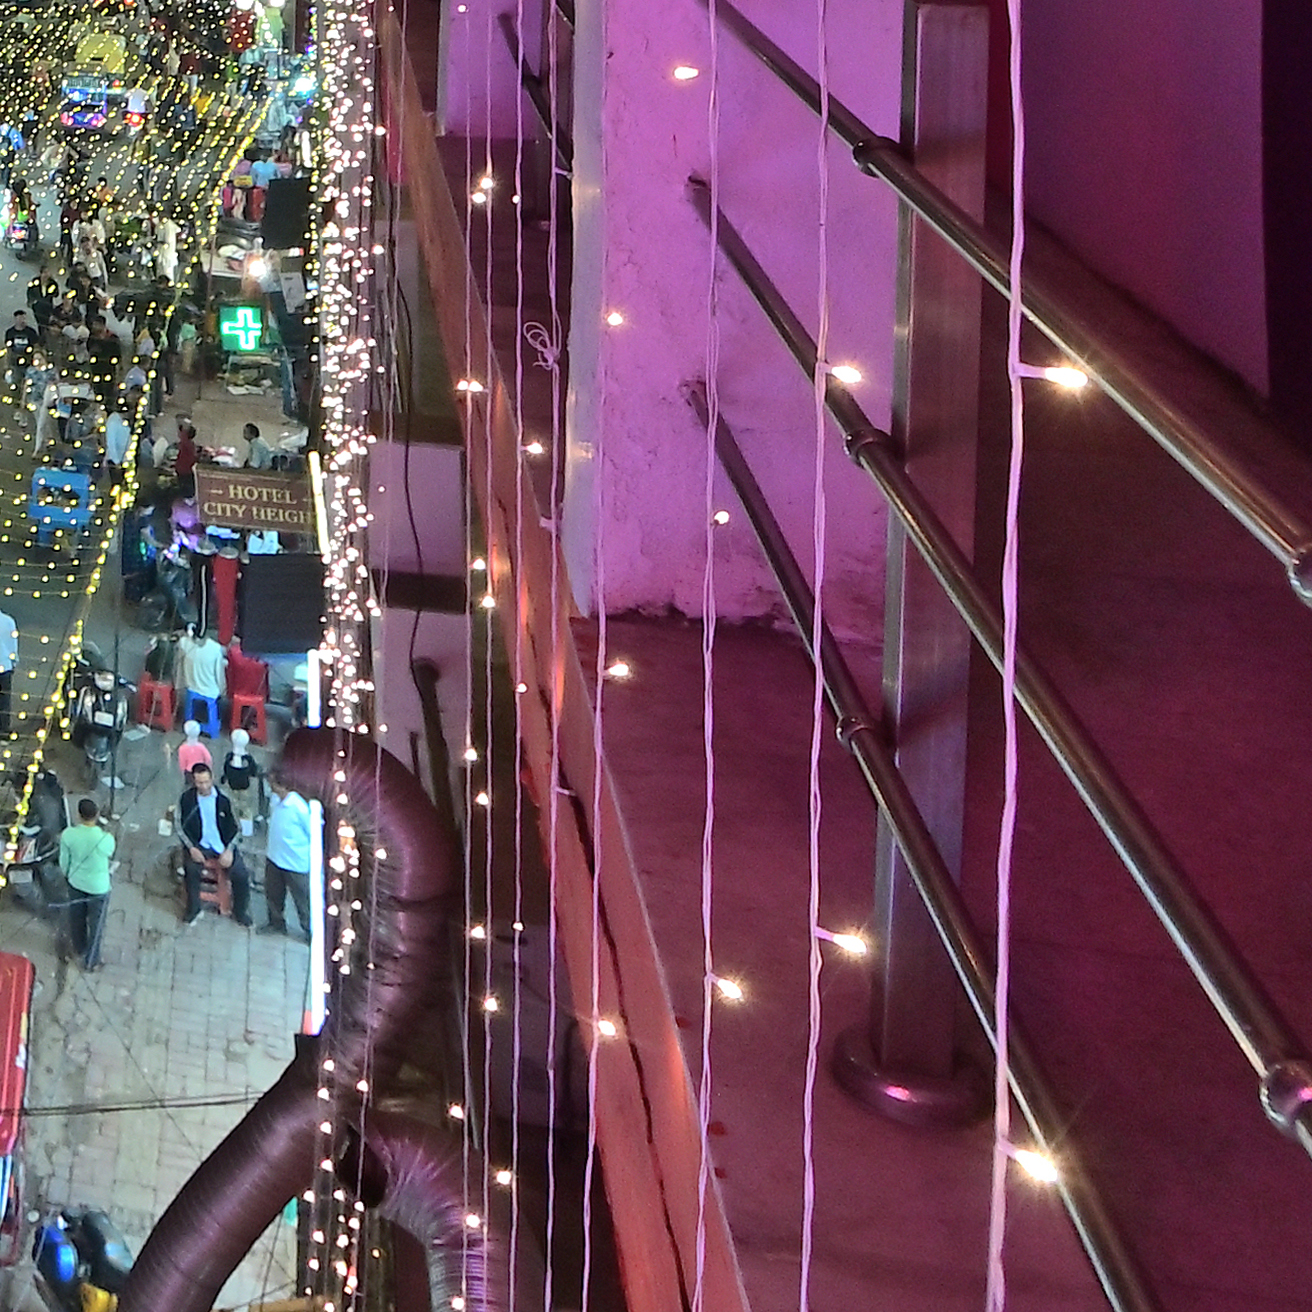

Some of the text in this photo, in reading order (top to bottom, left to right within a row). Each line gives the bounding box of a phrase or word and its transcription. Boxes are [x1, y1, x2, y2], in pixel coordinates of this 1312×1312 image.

[228, 484, 297, 505] HOTEL
[203, 502, 312, 524] CITY HEIGH
